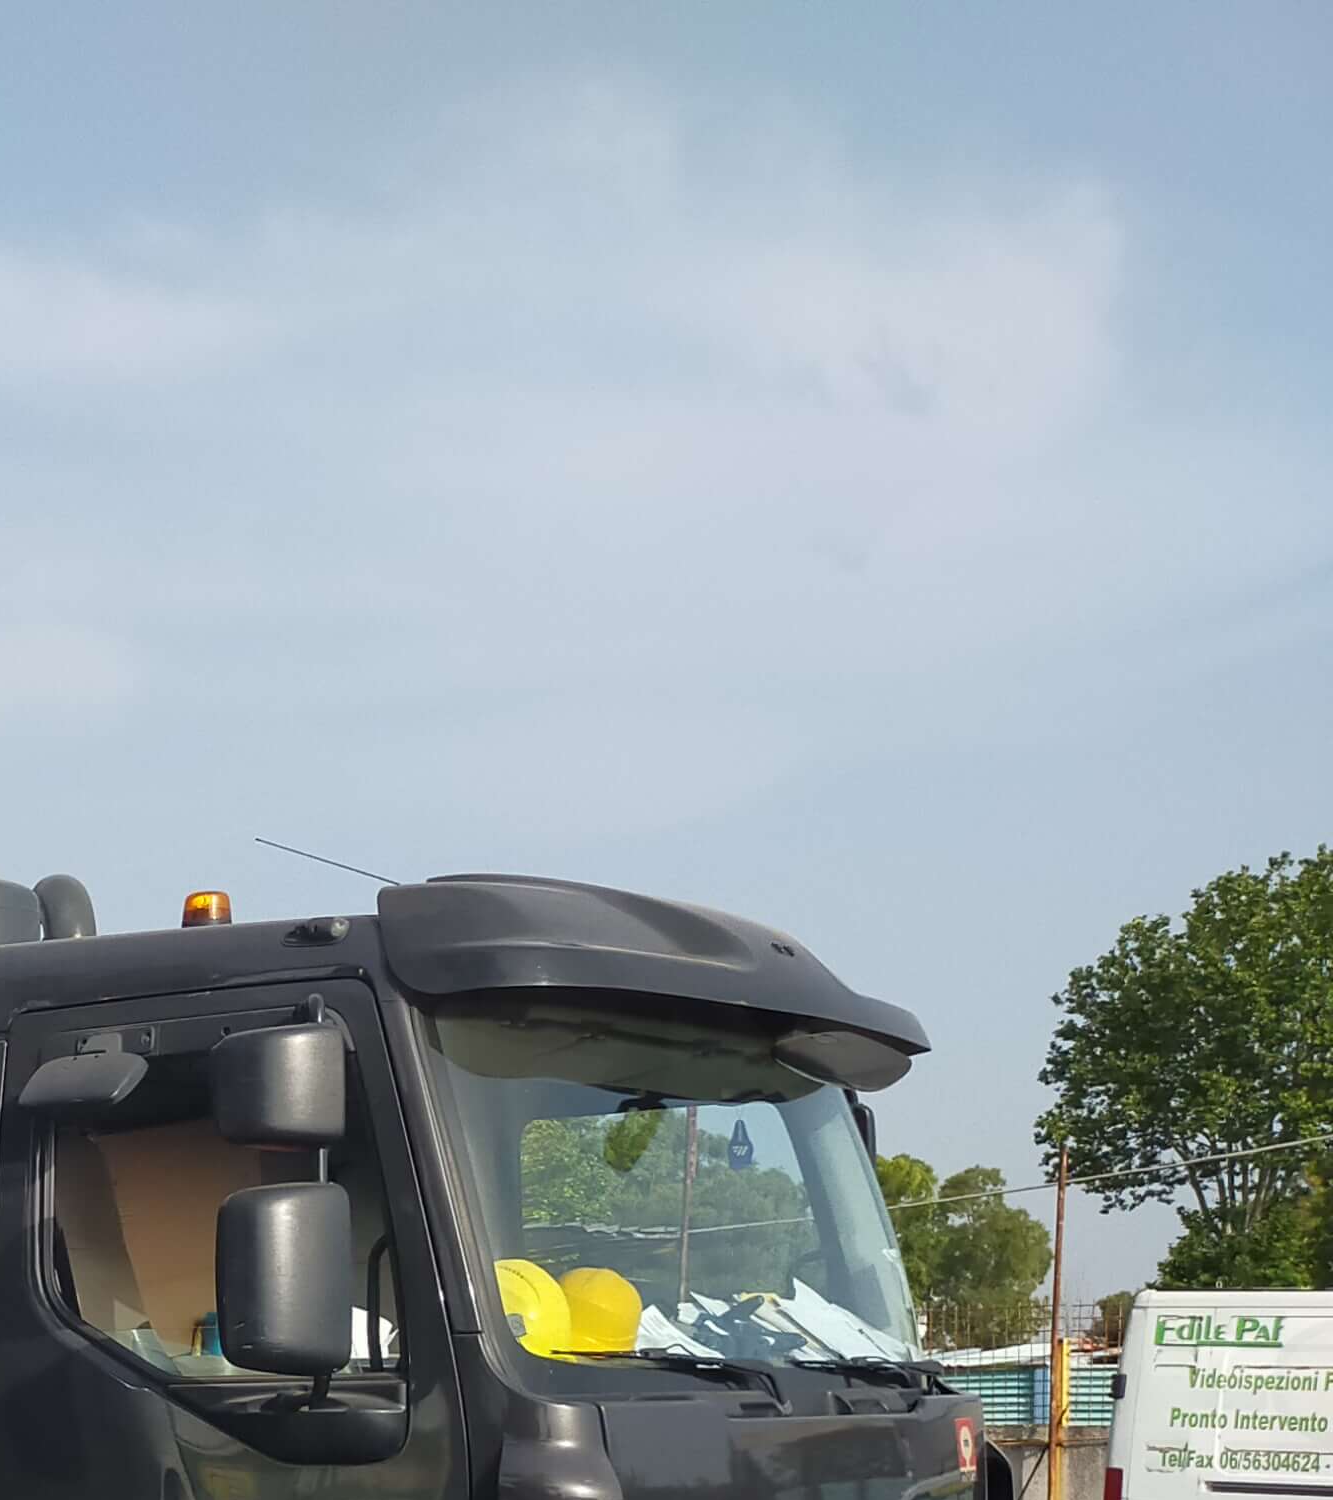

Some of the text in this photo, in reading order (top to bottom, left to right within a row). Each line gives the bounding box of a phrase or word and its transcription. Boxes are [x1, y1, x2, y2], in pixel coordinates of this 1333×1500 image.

[1189, 1368, 1318, 1395] Videoispezioni
[1170, 1407, 1329, 1433] Pronto Intervento
